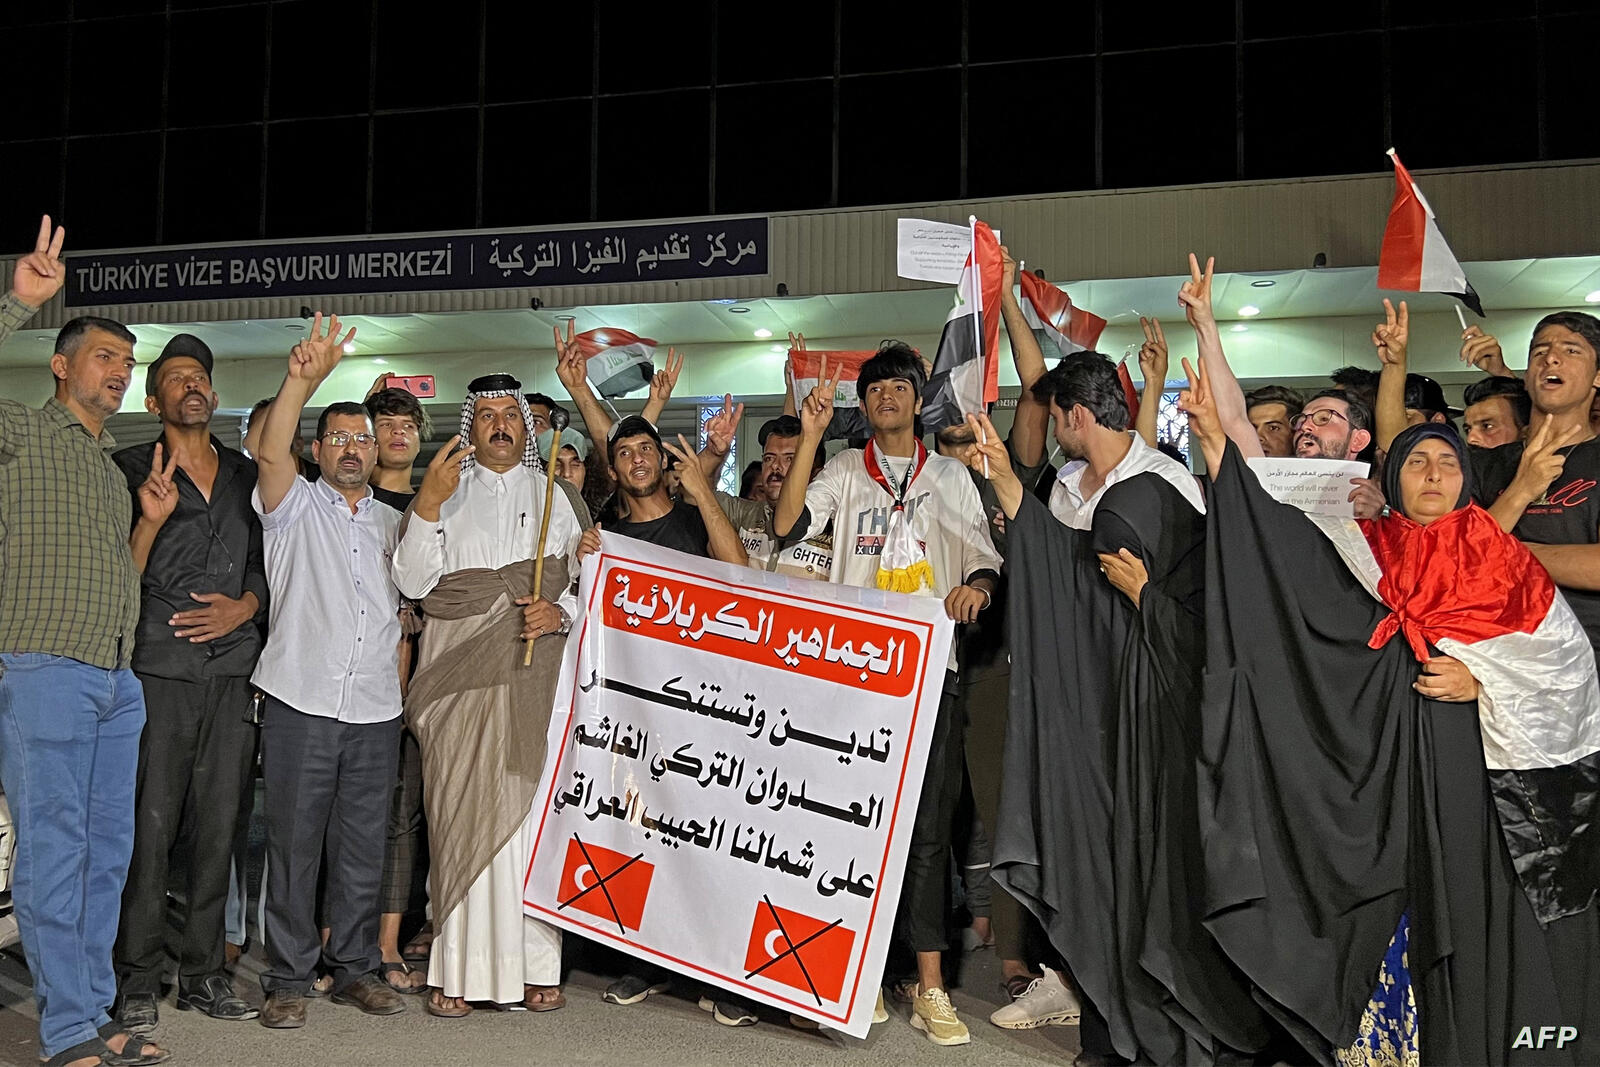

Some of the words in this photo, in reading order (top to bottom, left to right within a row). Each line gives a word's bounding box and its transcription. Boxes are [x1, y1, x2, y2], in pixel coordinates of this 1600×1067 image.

[76, 258, 169, 294] TÜRKİYE
[175, 255, 223, 287] VİZE
[229, 254, 340, 289] BAŞVURU
[347, 243, 452, 279] MERKEZİ
[488, 238, 561, 278] التركية
[572, 235, 627, 274] الفيزا
[635, 232, 691, 276] تقديم
[699, 232, 757, 268] مركز
[1284, 483, 1304, 492] world
[611, 573, 775, 646] الكربلائية
[773, 623, 907, 683] الجماهير
[571, 714, 649, 762] الغاشم
[769, 707, 893, 765] تدين
[649, 742, 746, 789] التركي
[553, 769, 640, 824] العراقي
[745, 766, 885, 831] العدوان
[640, 804, 727, 851] الحبيب
[729, 822, 815, 880] شمالنا
[816, 857, 876, 899] على
